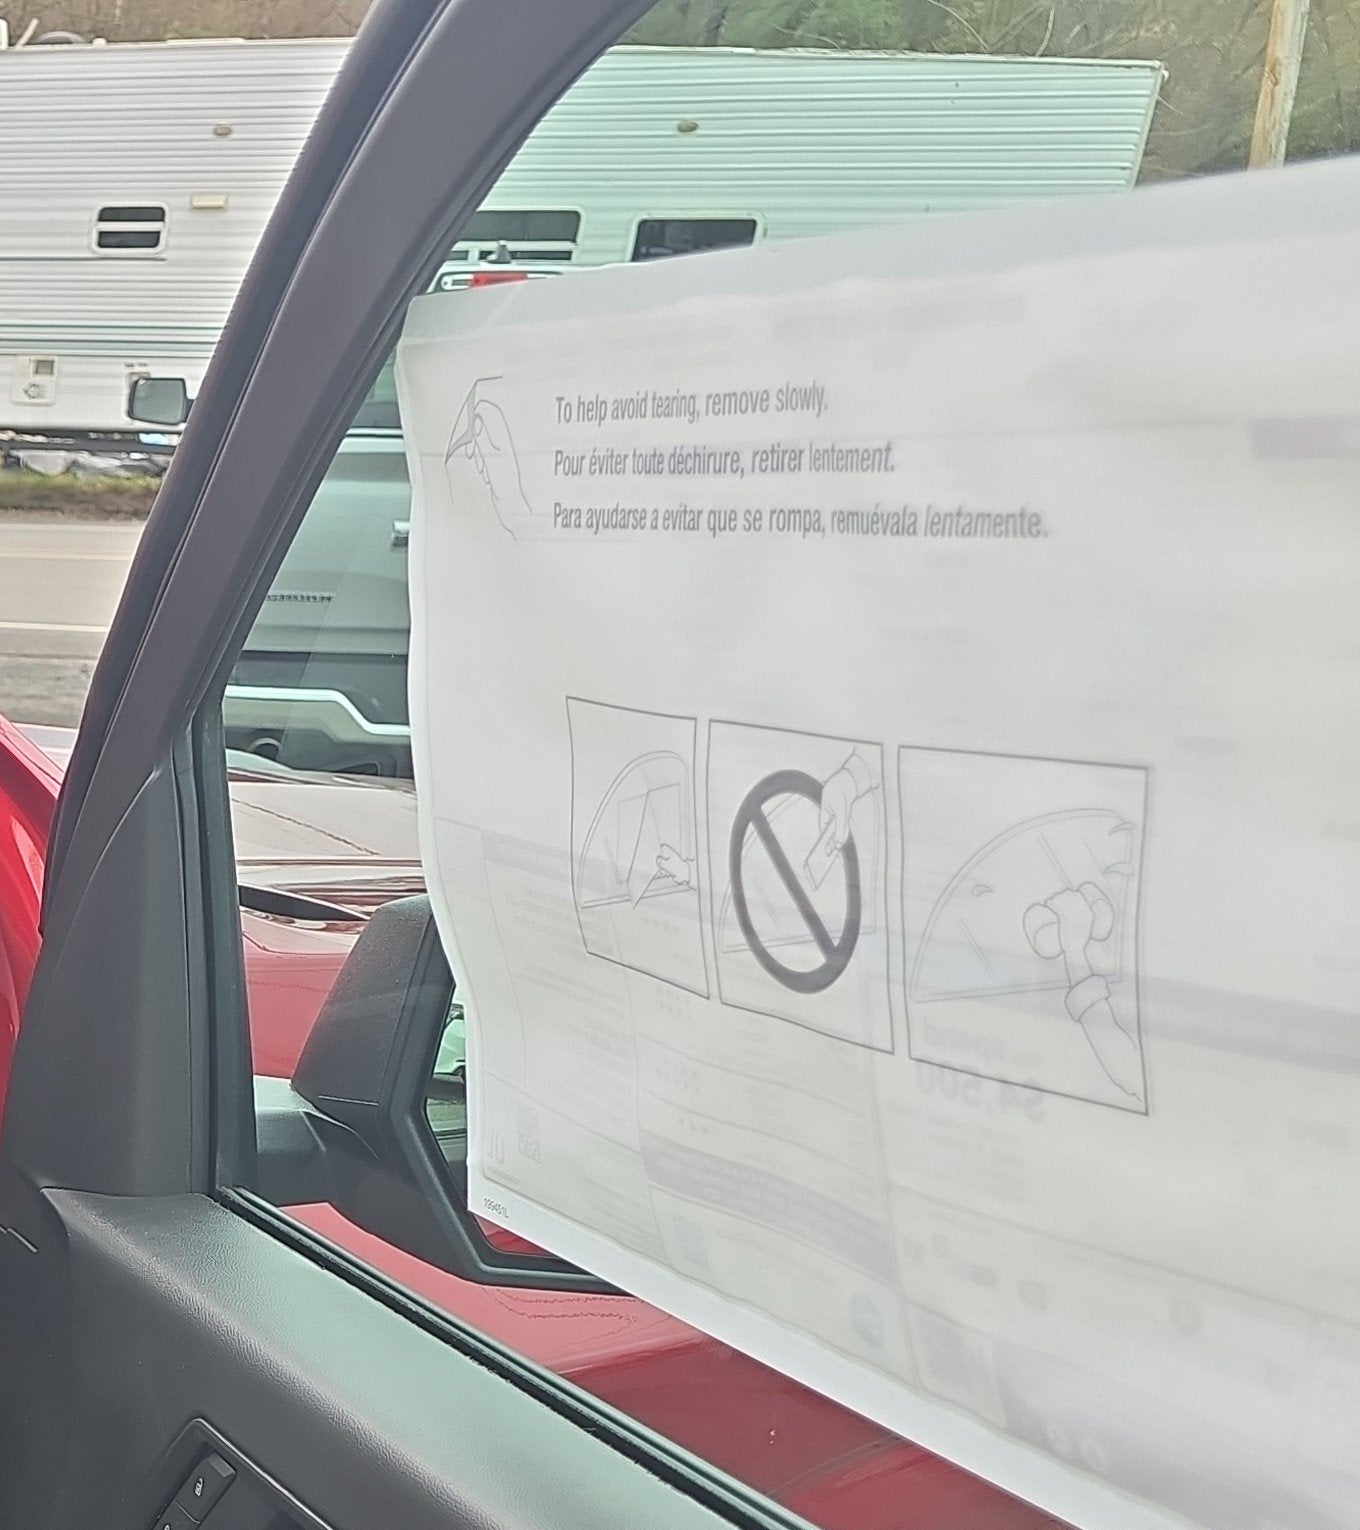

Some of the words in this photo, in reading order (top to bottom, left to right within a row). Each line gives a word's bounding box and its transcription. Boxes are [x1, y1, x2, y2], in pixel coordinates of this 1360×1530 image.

[556, 396, 572, 423] To
[577, 394, 607, 427] help
[611, 391, 647, 421] avoid
[652, 389, 700, 424] tearing,
[705, 389, 769, 416] remove
[776, 380, 828, 417] slowly.
[554, 450, 586, 477] Pour
[589, 447, 628, 476] éviter
[632, 447, 664, 476] toute
[668, 445, 745, 479] déchirure,
[751, 442, 804, 473] retirer
[808, 441, 895, 473] lentement.
[553, 502, 582, 529] Para
[586, 503, 647, 535] ayudarse
[650, 509, 659, 531] a
[662, 504, 702, 532] evitar
[707, 508, 737, 538] que
[743, 509, 762, 532] se
[768, 508, 827, 538] rompa,
[831, 503, 918, 537] remuévala
[923, 505, 1050, 539] lentamente.
